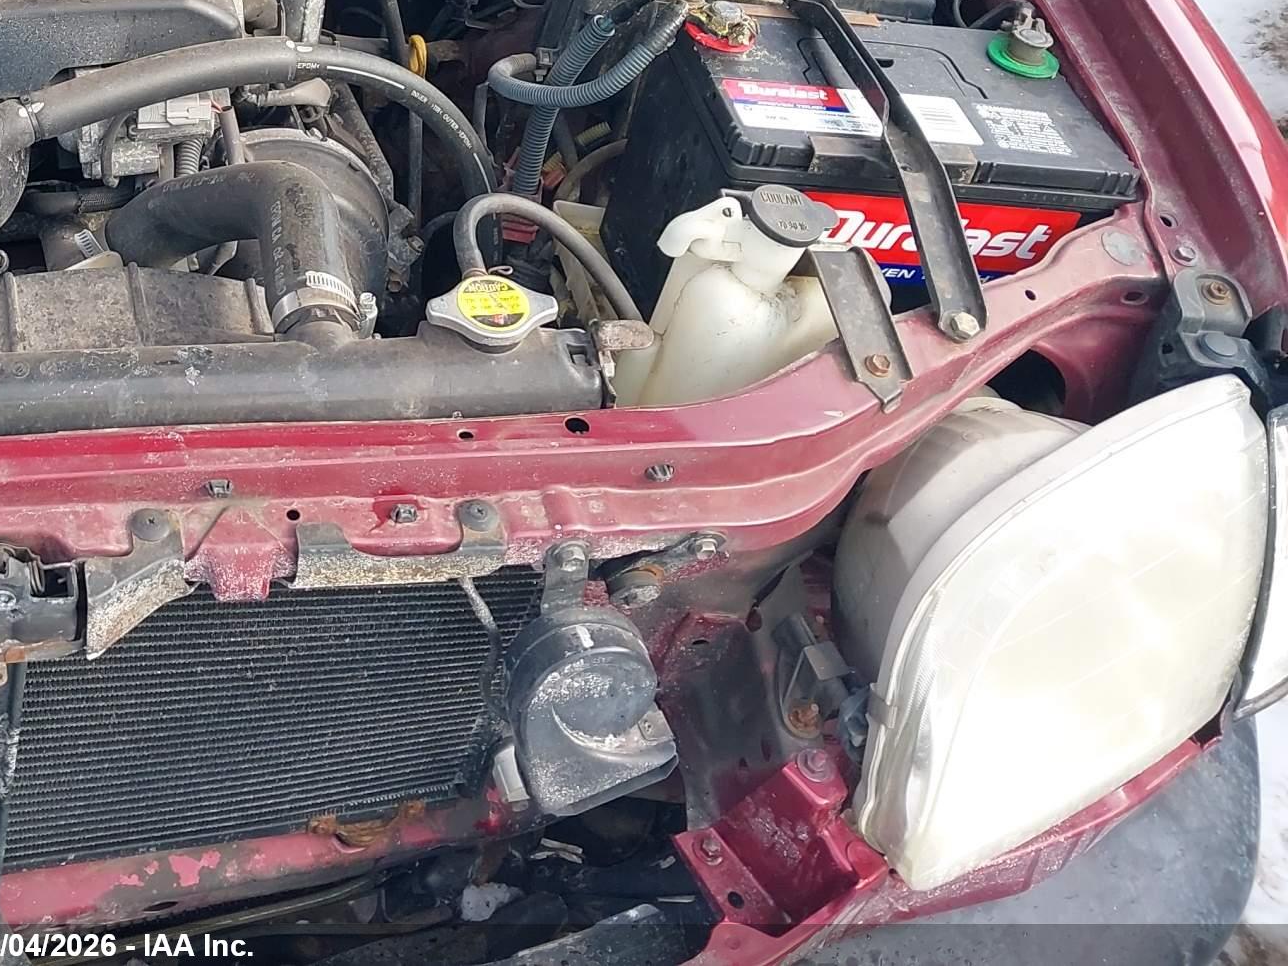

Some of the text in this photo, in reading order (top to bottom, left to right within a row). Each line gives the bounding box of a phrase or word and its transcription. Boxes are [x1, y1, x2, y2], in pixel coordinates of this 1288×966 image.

[738, 83, 829, 101] Duralast
[759, 191, 803, 206] COOLANT
[821, 209, 1051, 260] Duraast
